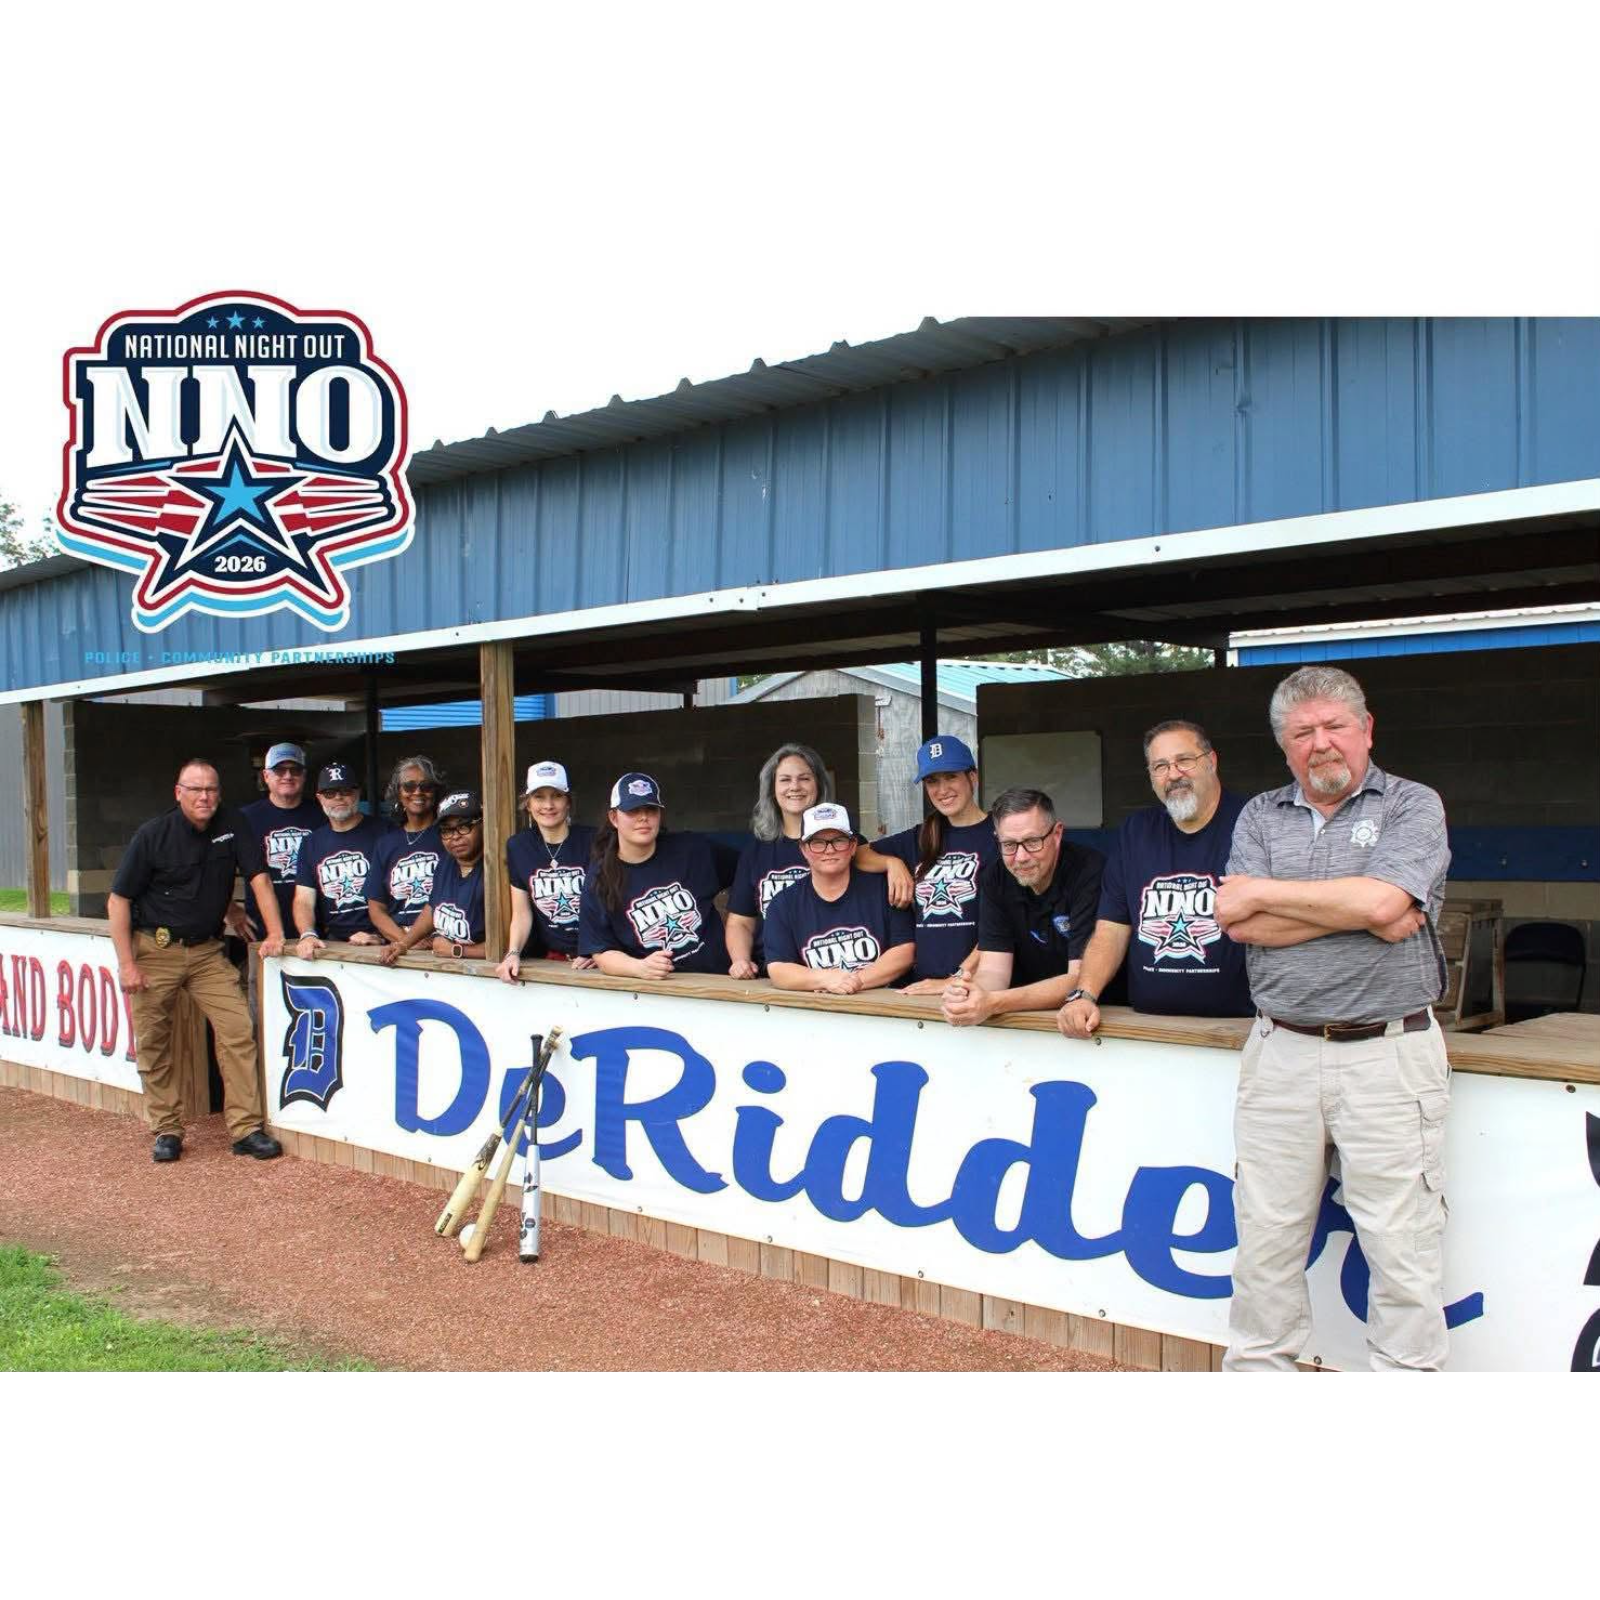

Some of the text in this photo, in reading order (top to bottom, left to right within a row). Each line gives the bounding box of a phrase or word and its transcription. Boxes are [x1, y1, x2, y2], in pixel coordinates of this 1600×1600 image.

[321, 859, 368, 884] NNO
[631, 891, 694, 932] NNO
[1143, 887, 1218, 918] NNO
[806, 937, 877, 970] NNO
[280, 970, 345, 1112] D
